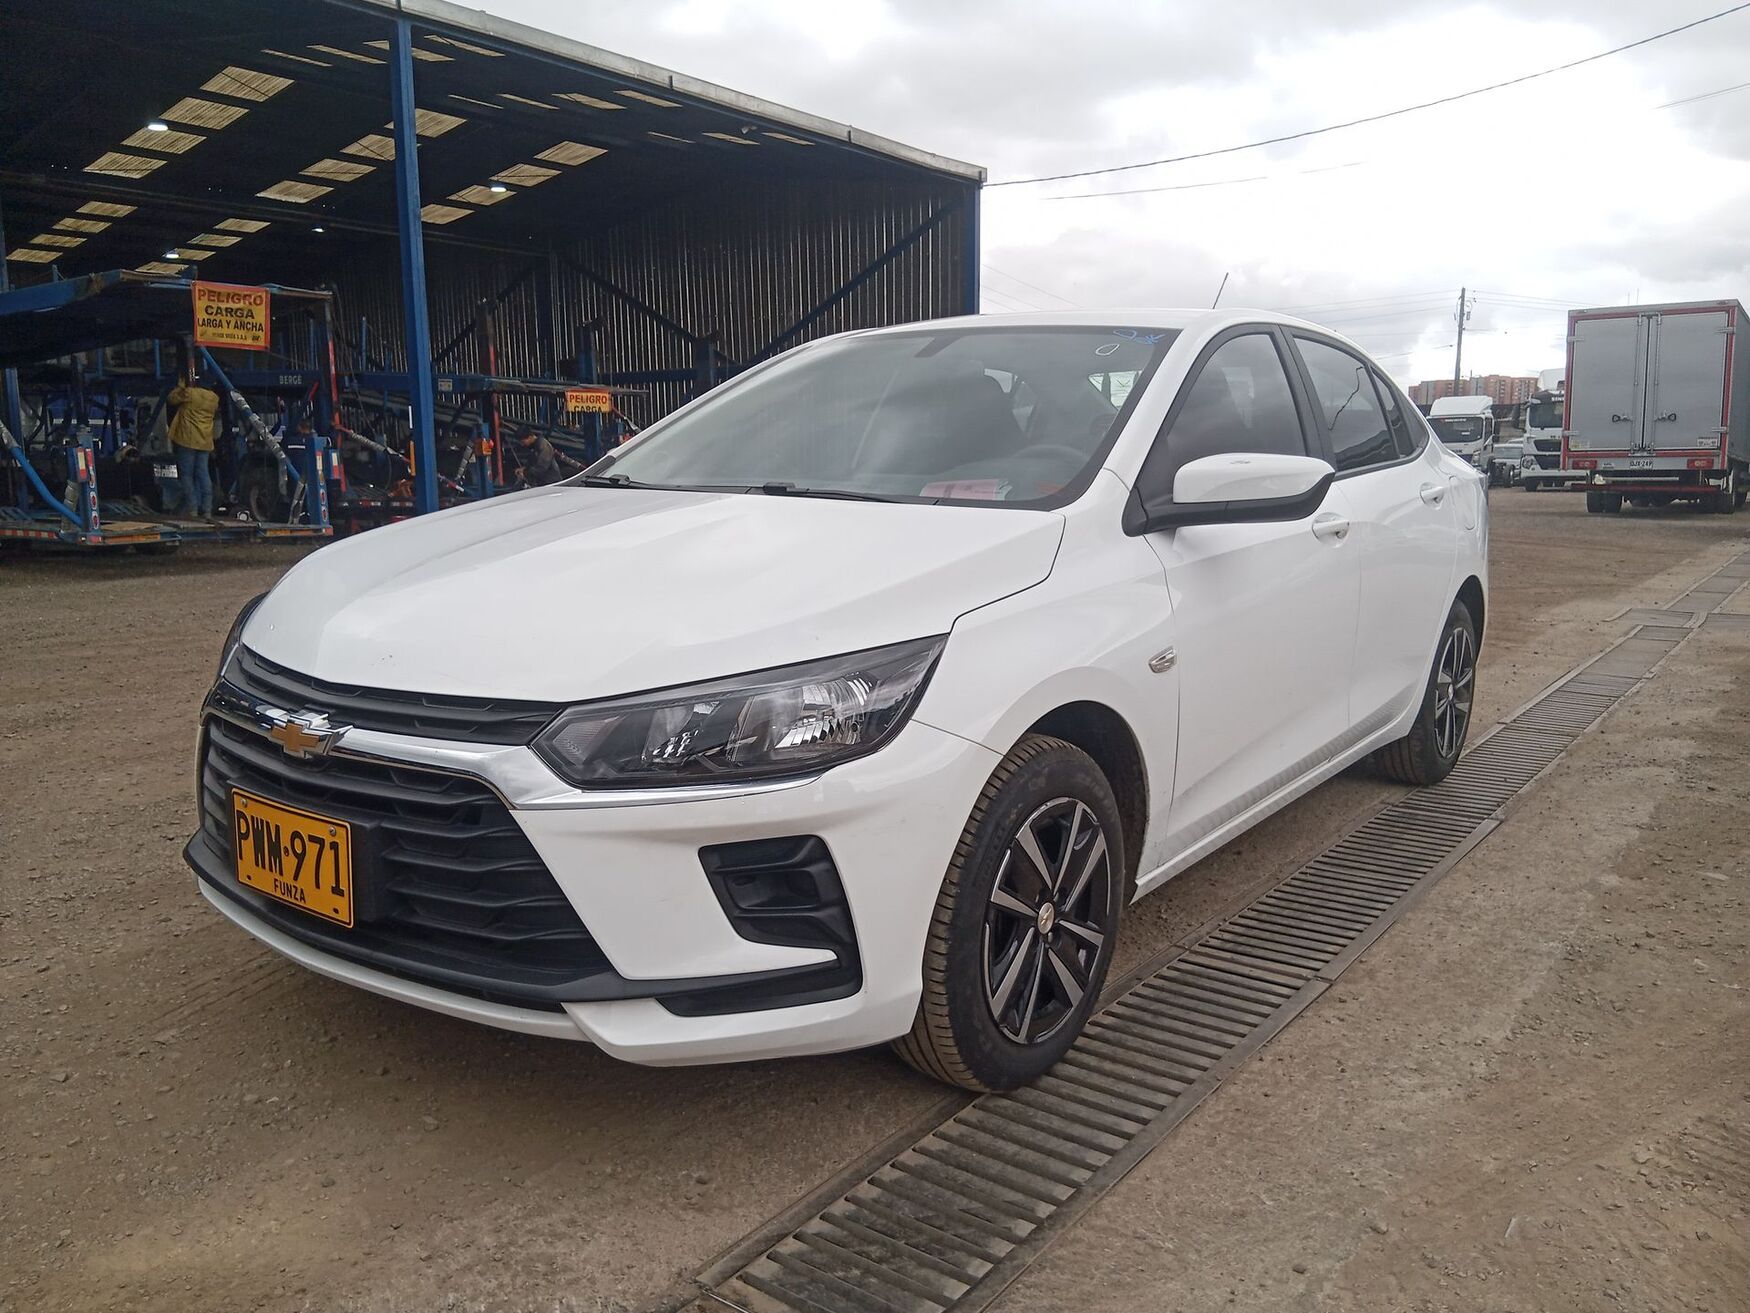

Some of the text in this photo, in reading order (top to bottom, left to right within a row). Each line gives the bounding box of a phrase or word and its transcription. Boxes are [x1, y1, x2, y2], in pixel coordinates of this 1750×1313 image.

[197, 288, 264, 306] PELIGRO
[204, 305, 255, 319] CARGA
[197, 318, 264, 332] LARGA Y ANCHA
[569, 394, 608, 405] PELIGRO
[273, 877, 307, 905] FUNZA
